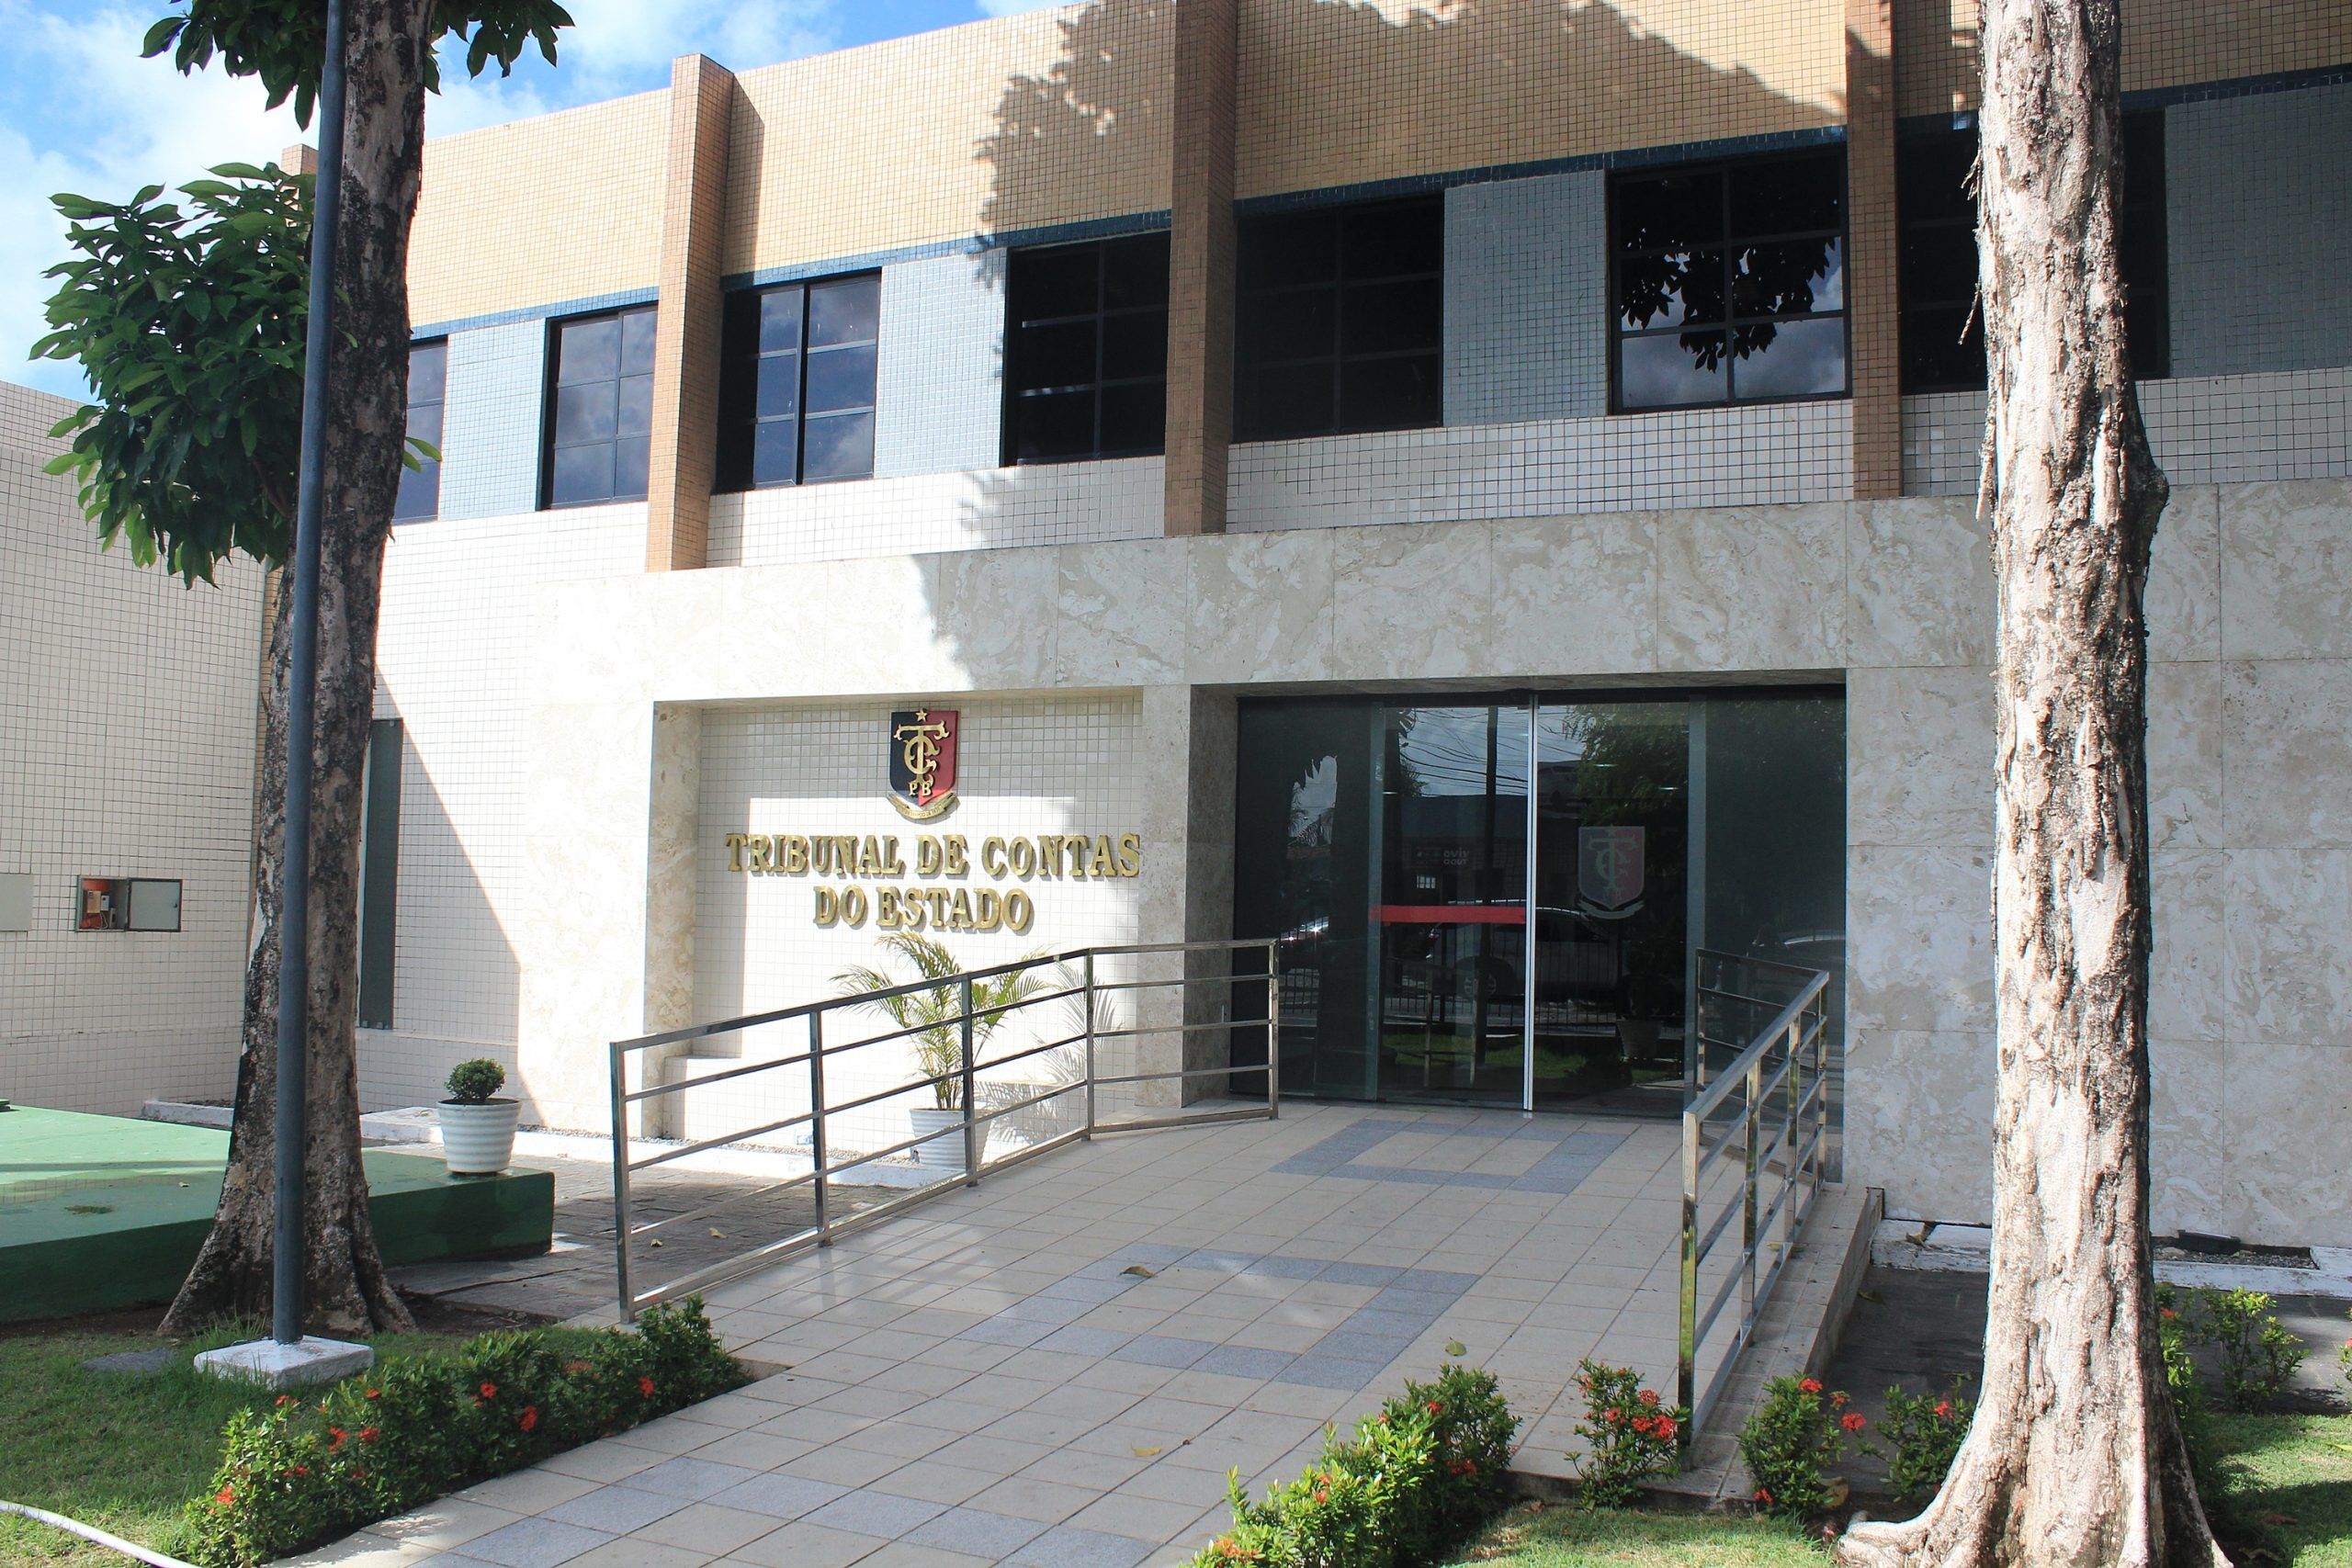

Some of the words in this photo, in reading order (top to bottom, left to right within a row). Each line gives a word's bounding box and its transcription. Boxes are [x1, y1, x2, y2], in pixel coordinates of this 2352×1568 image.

[724, 833, 906, 874] TRIBUNAL
[914, 834, 969, 875] DE
[981, 833, 1140, 877] CONTAS
[813, 885, 868, 926] DO
[876, 887, 1031, 931] ESTADO
